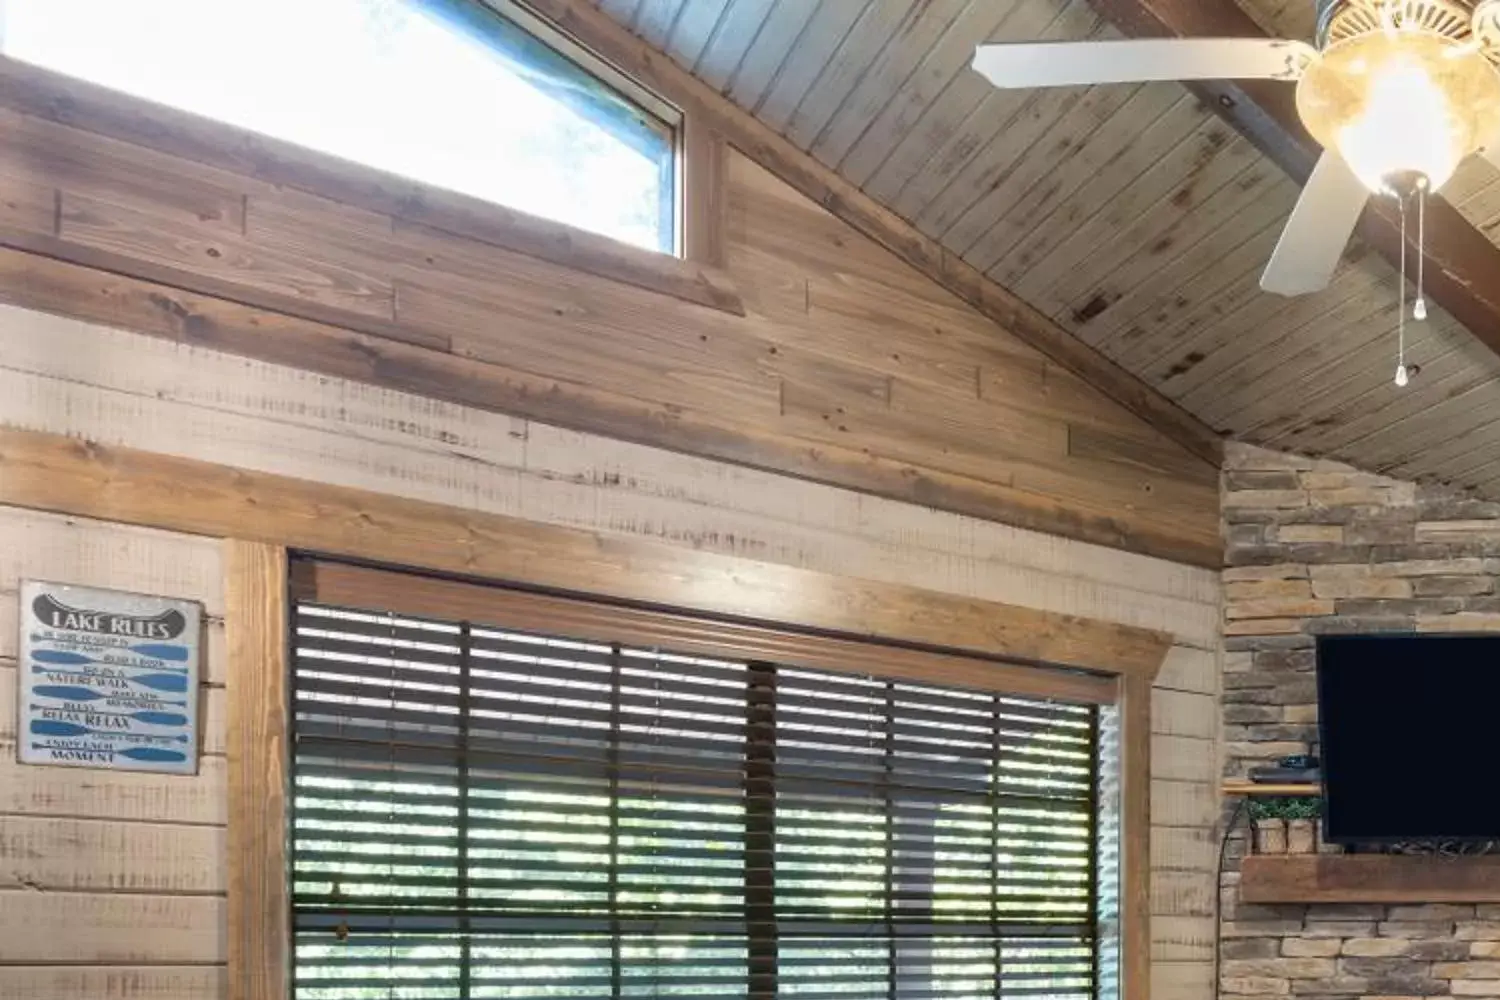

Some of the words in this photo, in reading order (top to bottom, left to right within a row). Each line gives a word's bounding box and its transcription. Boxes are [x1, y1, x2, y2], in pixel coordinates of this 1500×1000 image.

[52, 611, 102, 631] LAKE
[110, 616, 170, 638] RULES
[96, 676, 129, 689] WALK
[85, 712, 131, 729] RELAX
[51, 749, 114, 763] MOMENT
